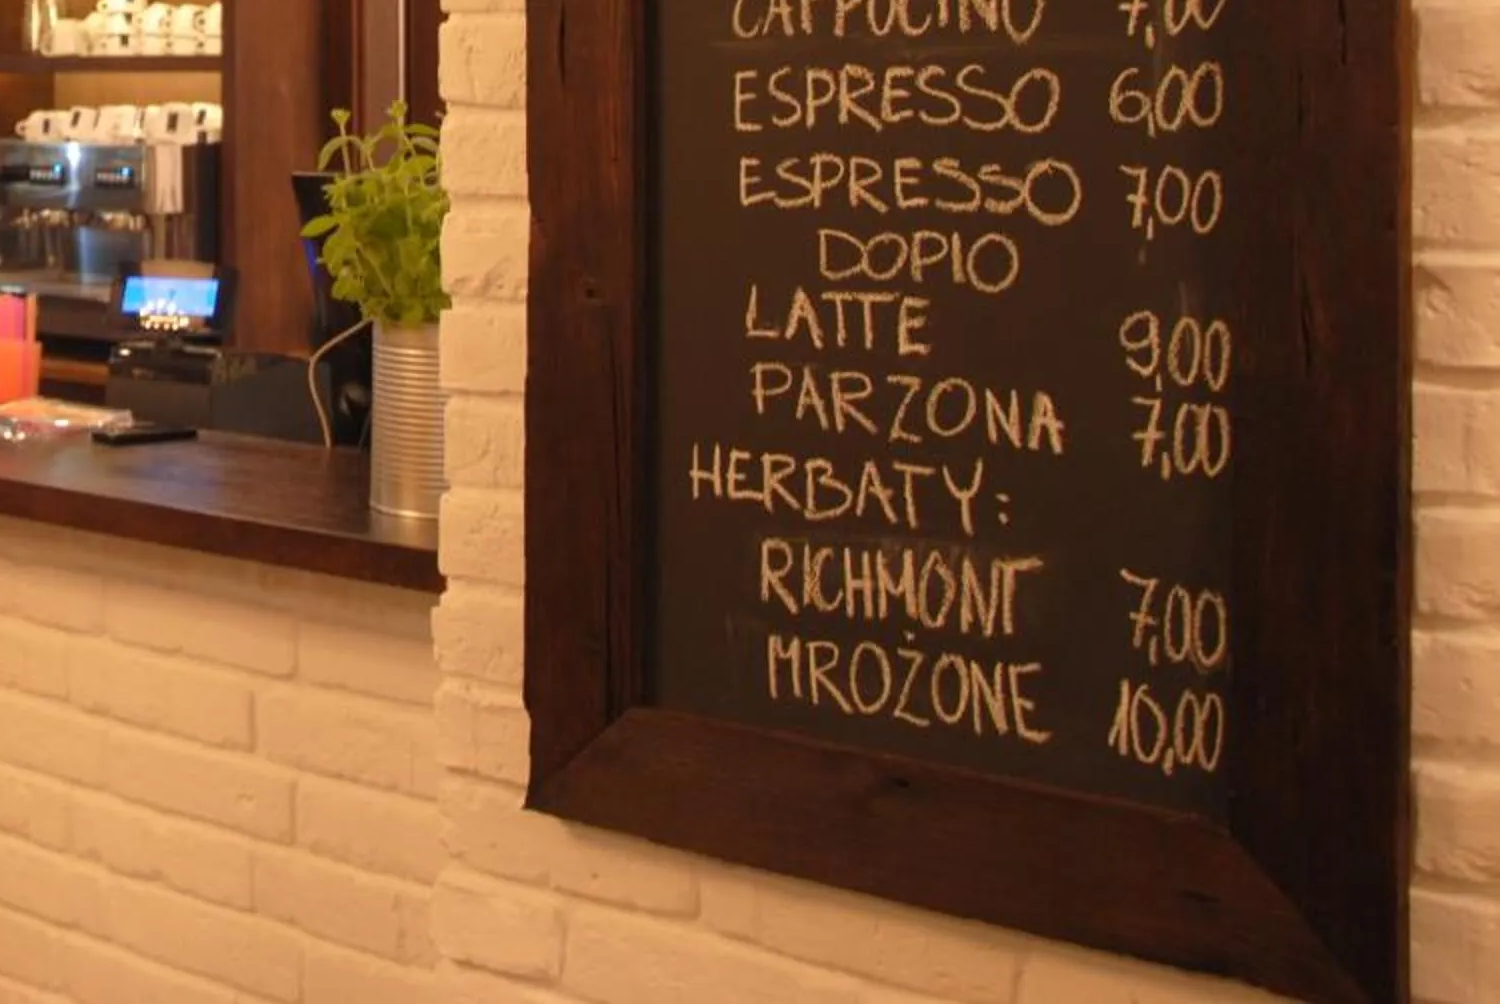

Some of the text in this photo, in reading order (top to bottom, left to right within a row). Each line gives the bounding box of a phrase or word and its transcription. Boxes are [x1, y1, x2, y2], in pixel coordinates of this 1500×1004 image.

[732, 58, 1228, 138] ESPRESSO 6,00
[736, 150, 1224, 242] ESPRESSO 7,00
[815, 226, 1022, 296] DOPIO
[742, 281, 1232, 394] LATTE 9,00
[748, 360, 1232, 482] PARZONA 7,00
[686, 440, 1012, 538] HERBATY:
[757, 534, 1230, 671] RICHMONT 7,00
[765, 631, 1226, 778] MROŻONE 10,00
